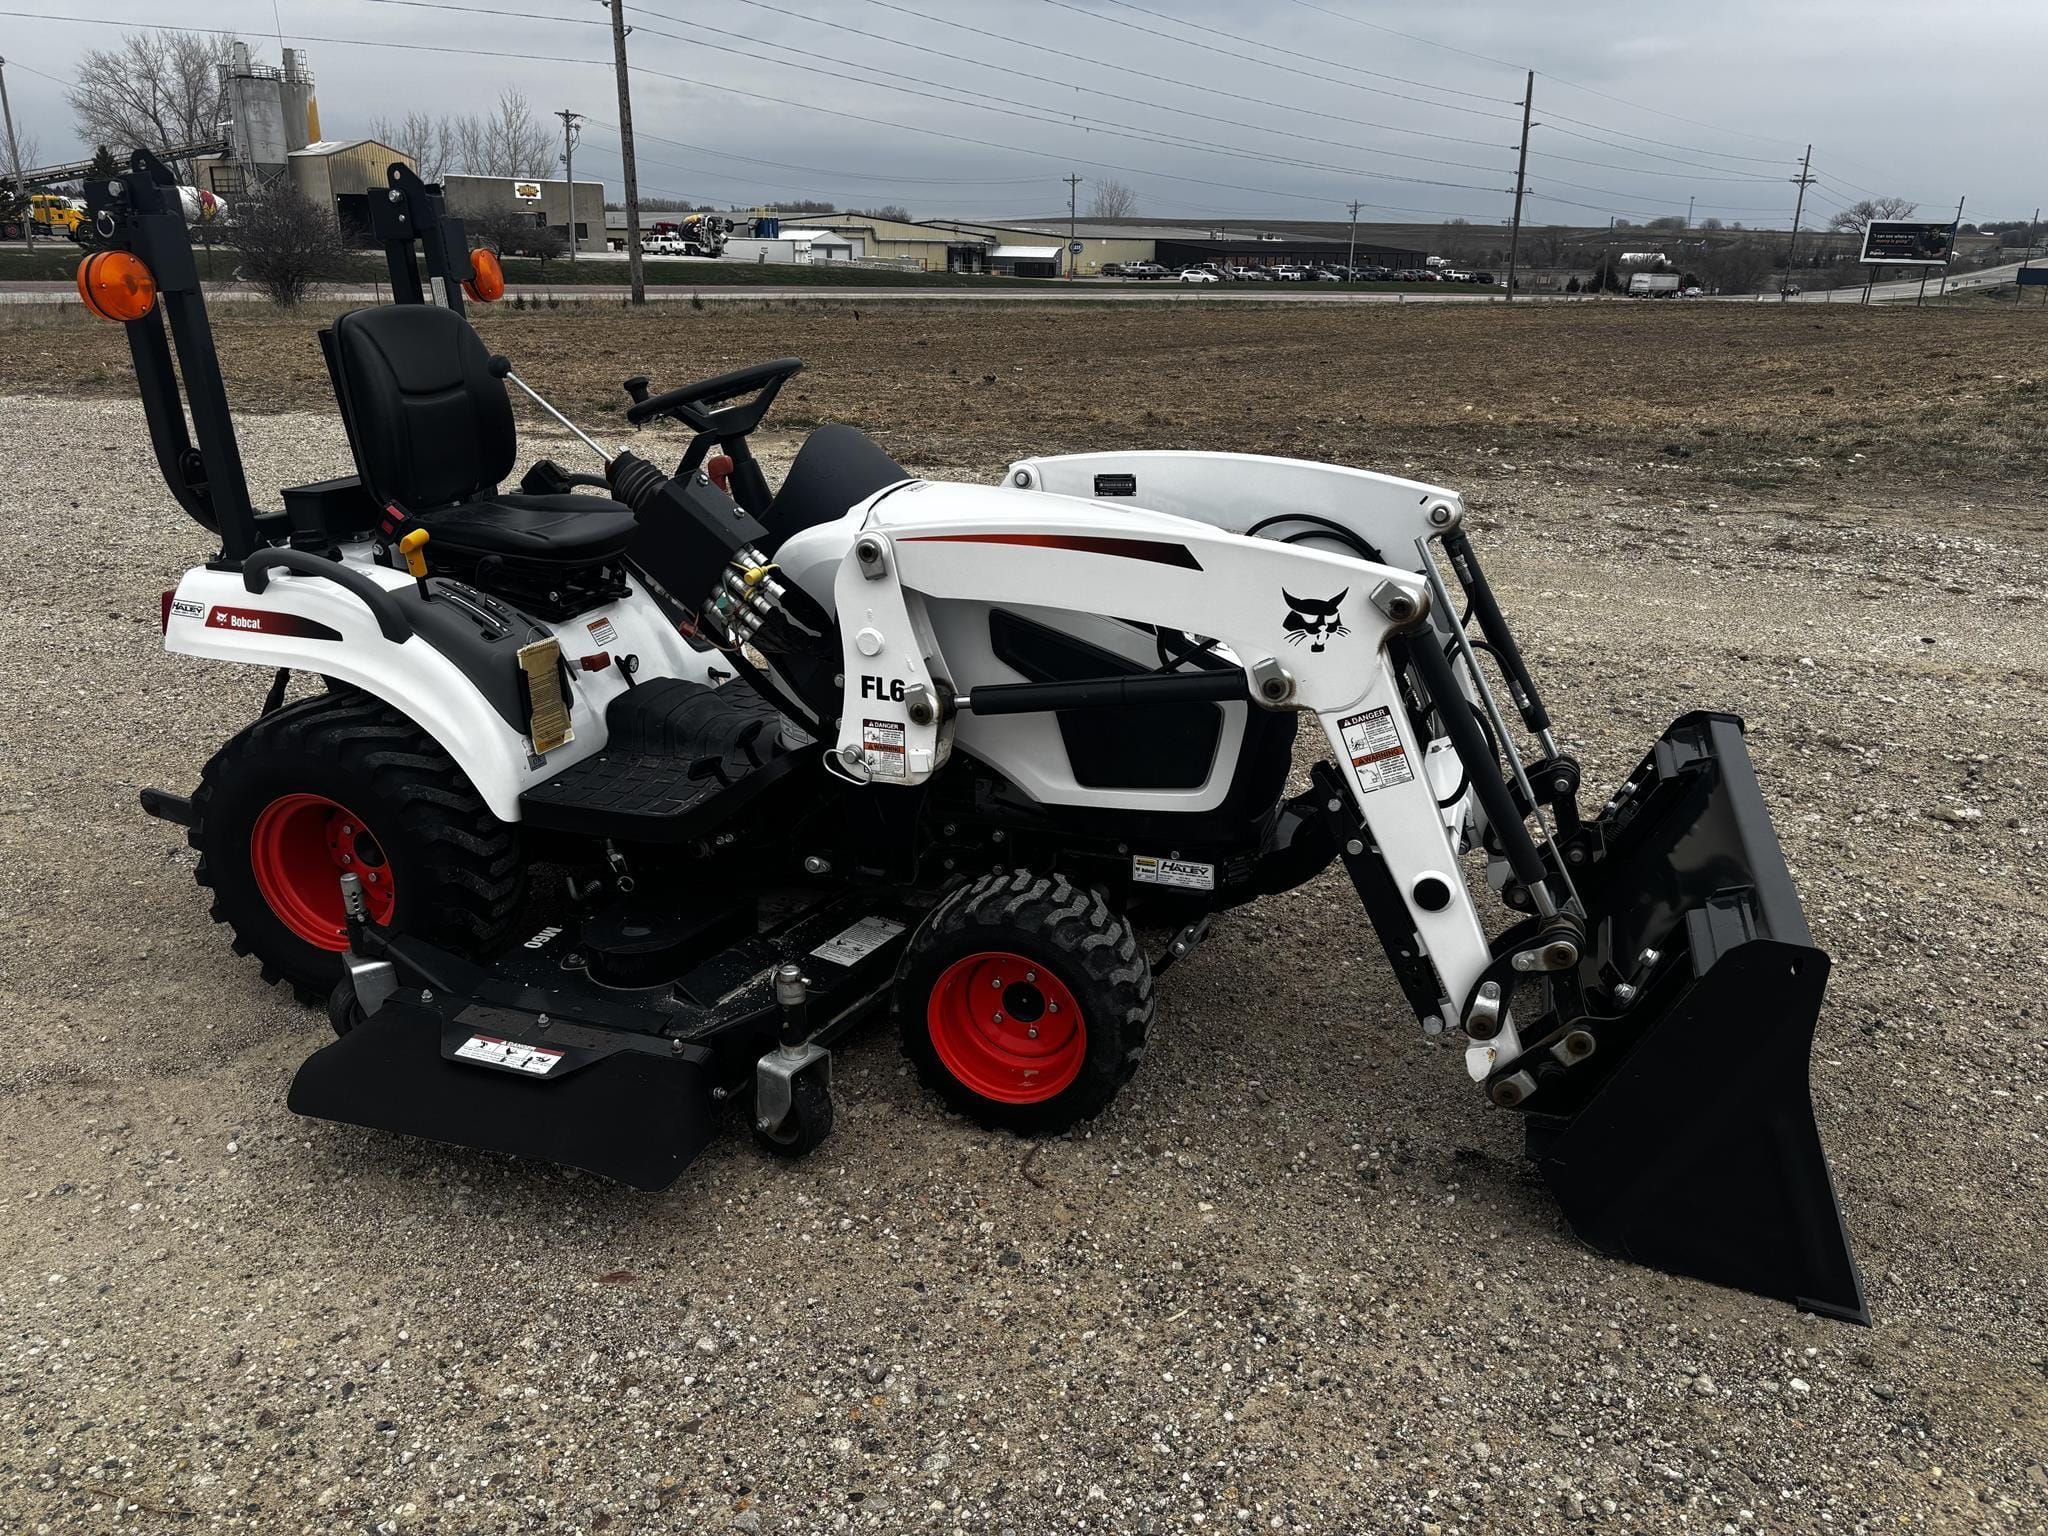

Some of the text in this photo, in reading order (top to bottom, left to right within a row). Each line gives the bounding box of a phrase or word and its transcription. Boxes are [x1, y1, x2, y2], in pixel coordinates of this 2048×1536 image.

[172, 602, 203, 613] HALEY
[231, 615, 260, 629] Bobcat
[861, 675, 905, 702] FL6
[1351, 709, 1386, 724] DANGER
[875, 722, 899, 730] DANGER
[1363, 748, 1400, 762] WARNING
[1161, 862, 1208, 875] HALEY
[524, 927, 563, 948] M60
